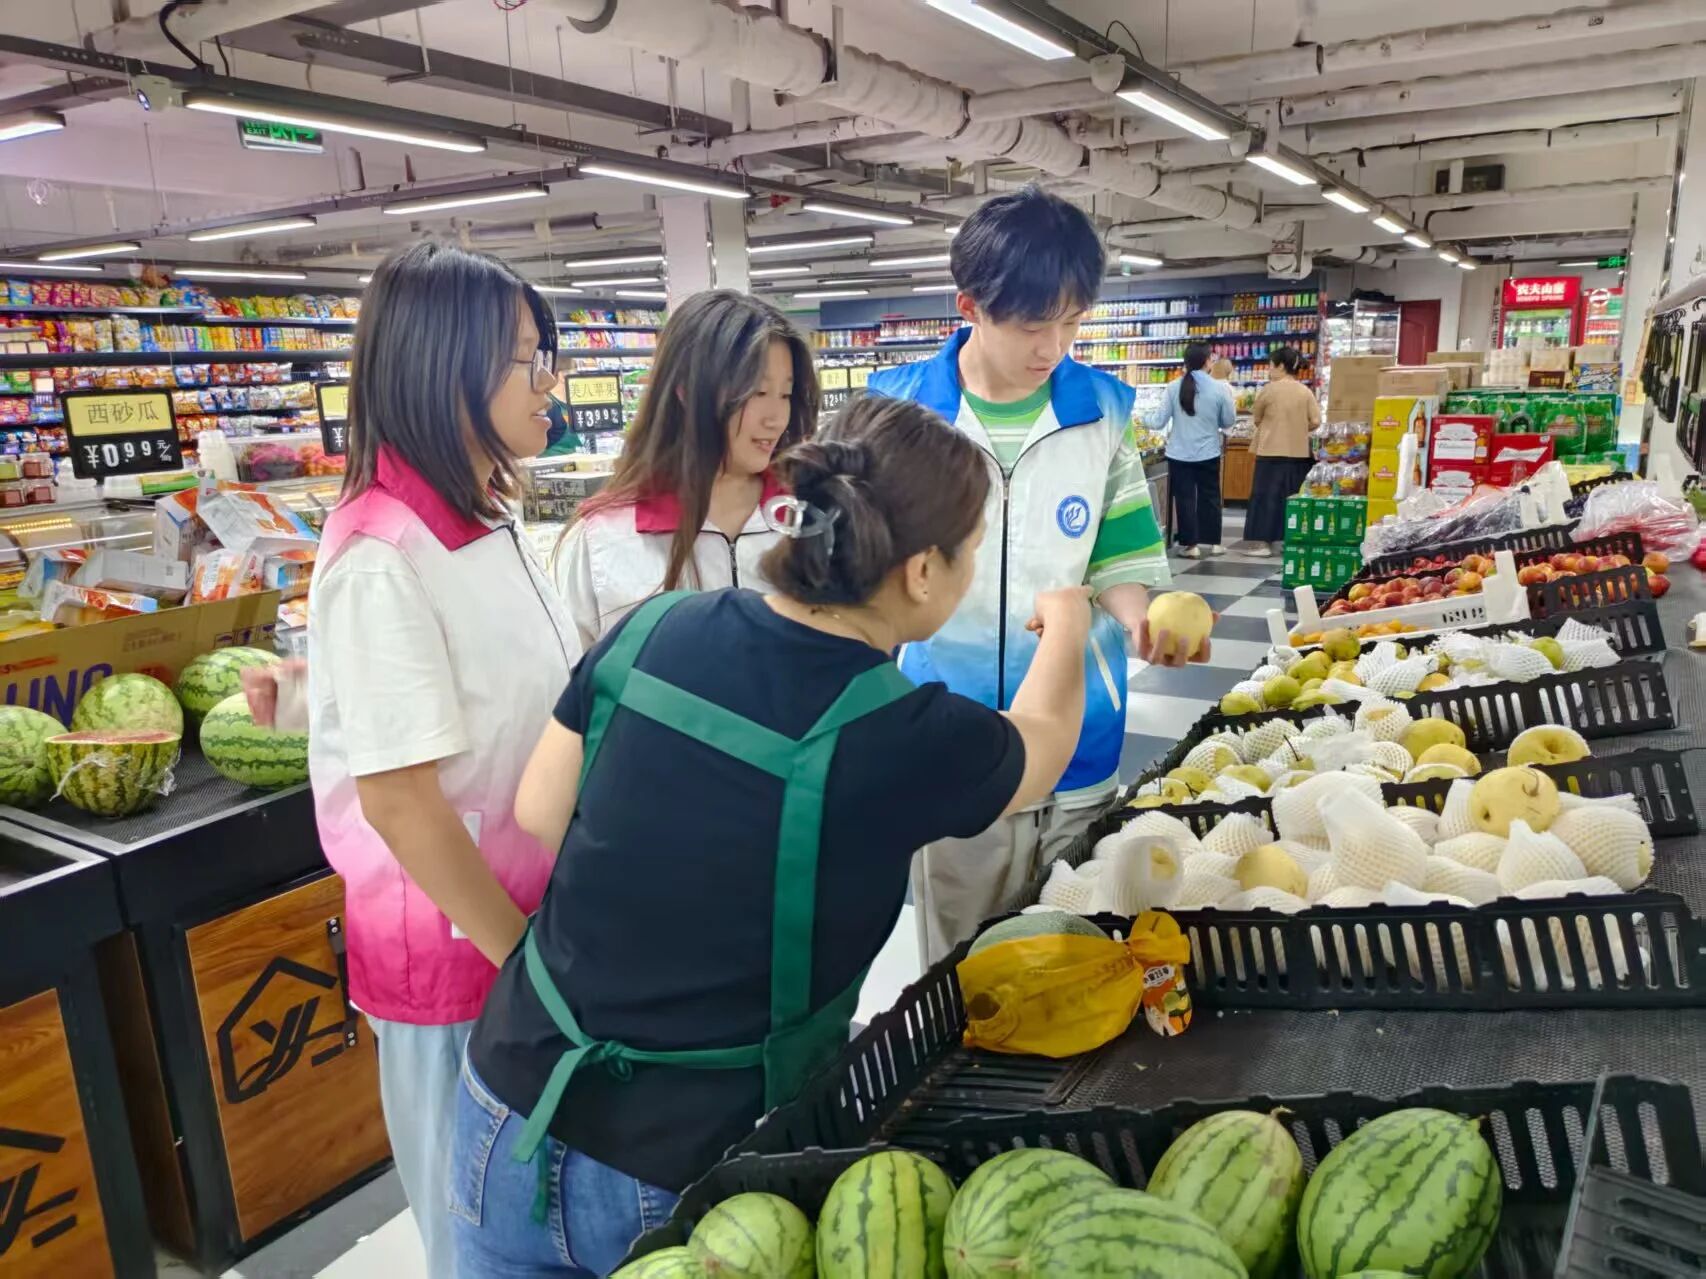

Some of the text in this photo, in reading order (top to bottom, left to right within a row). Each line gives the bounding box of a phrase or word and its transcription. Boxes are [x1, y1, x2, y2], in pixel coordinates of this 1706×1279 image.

[247, 127, 267, 135] EXIT
[83, 400, 160, 425] 西砂瓜
